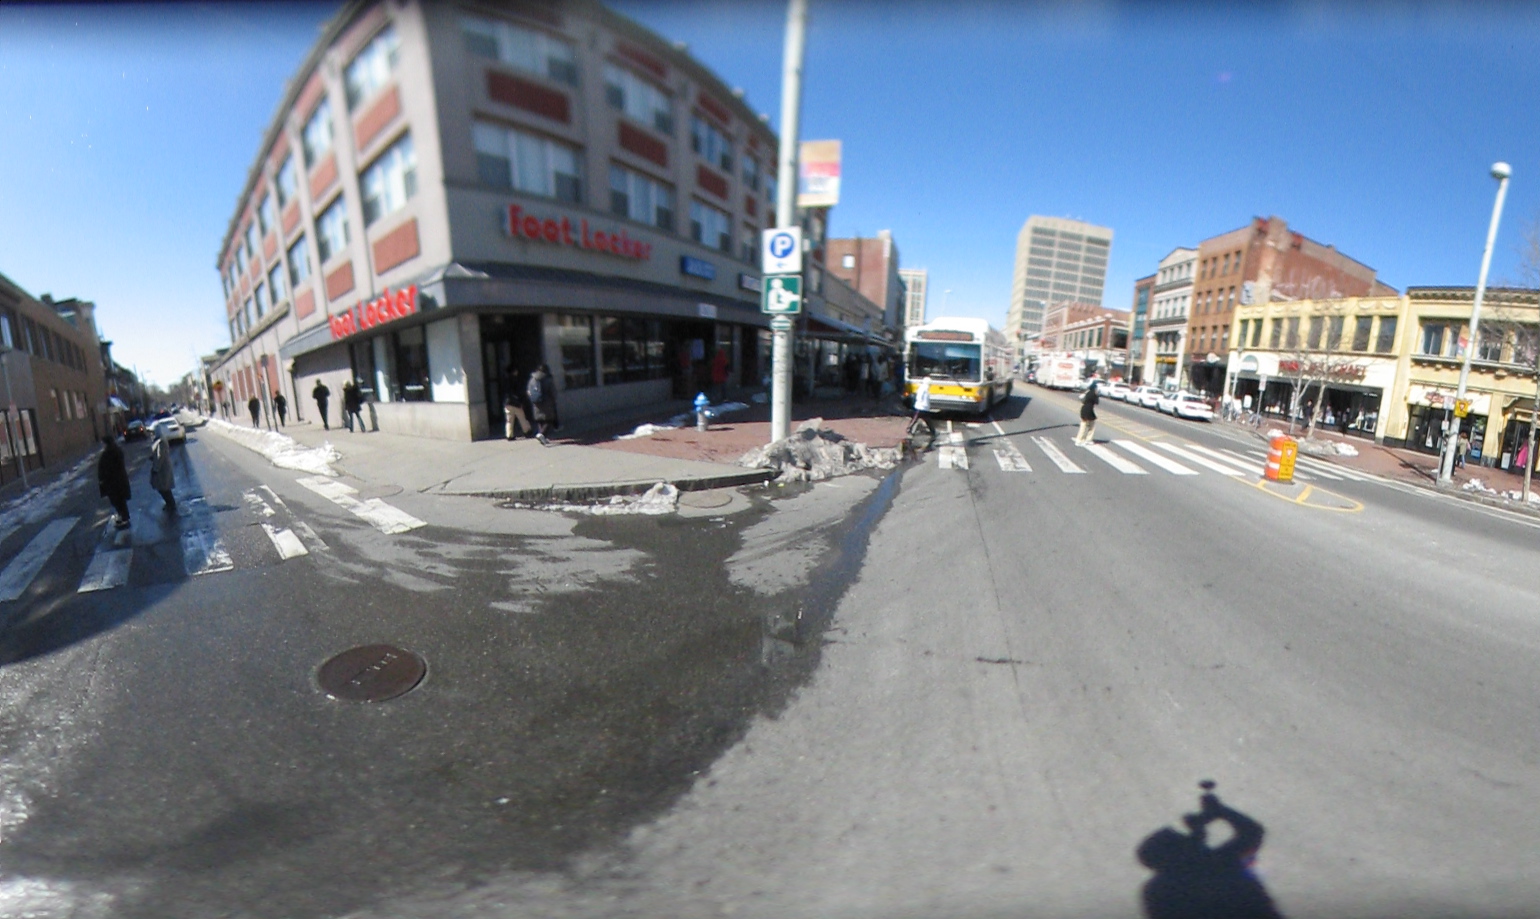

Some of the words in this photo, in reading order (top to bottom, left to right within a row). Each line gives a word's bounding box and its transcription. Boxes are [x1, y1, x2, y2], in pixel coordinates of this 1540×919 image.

[508, 203, 574, 245] Foot
[580, 217, 653, 260] Locker
[357, 284, 418, 331] Locker
